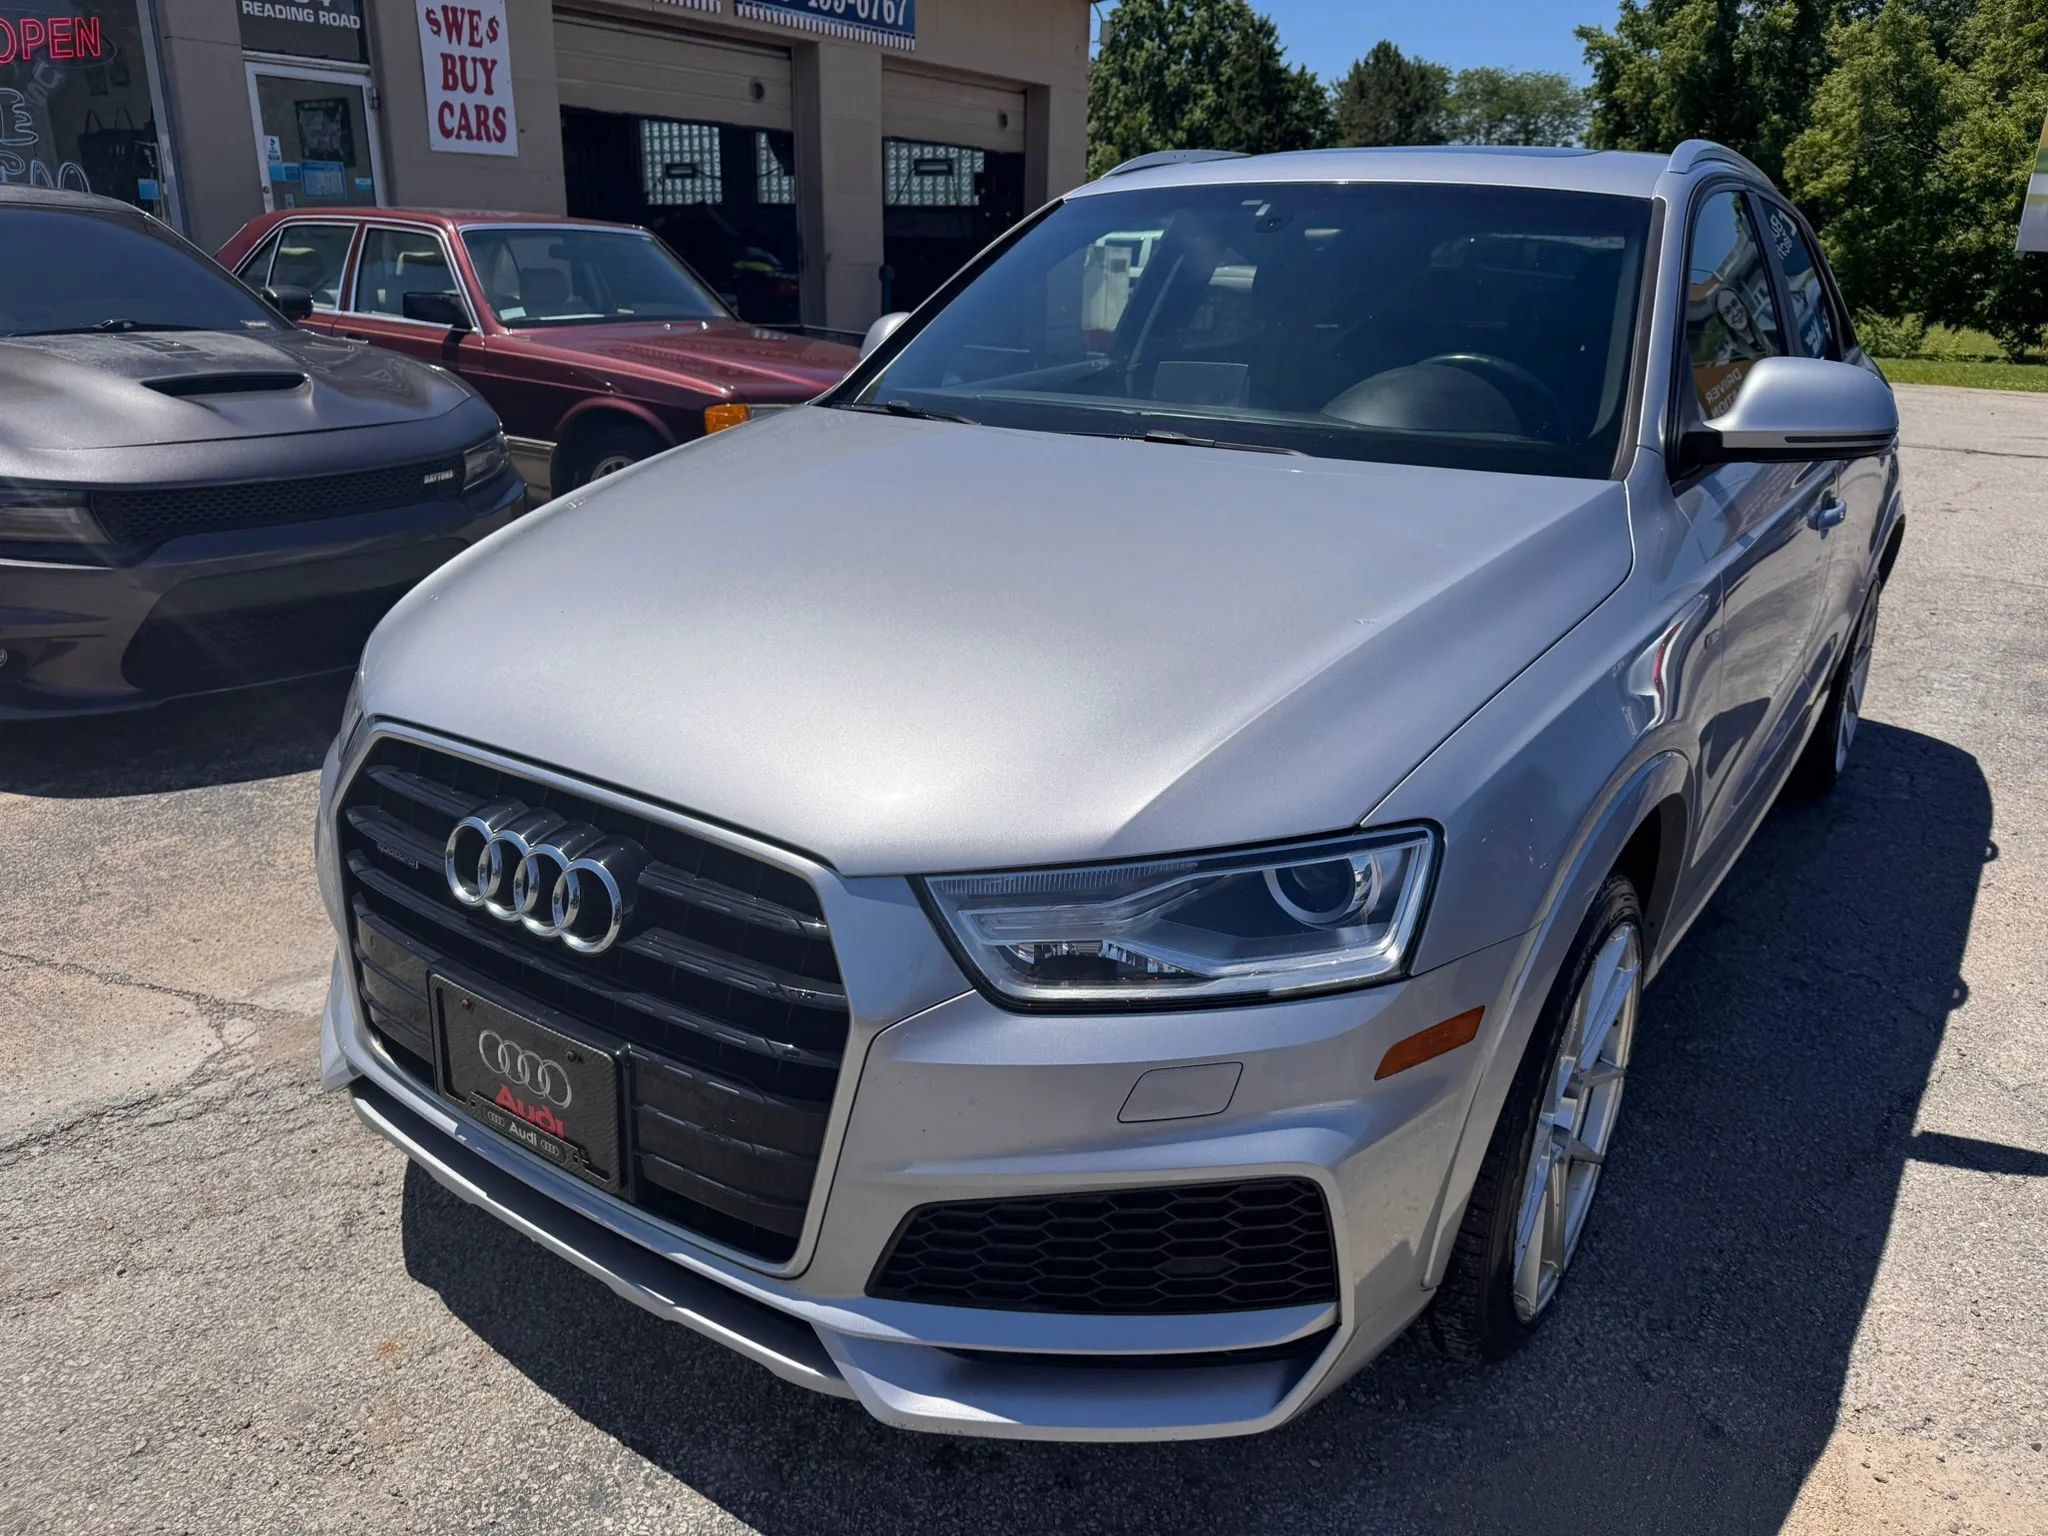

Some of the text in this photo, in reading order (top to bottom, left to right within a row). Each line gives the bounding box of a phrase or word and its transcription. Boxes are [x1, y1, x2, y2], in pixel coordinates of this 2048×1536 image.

[242, 1, 361, 29] READING ROAD
[440, 52, 497, 96] BUY
[438, 101, 507, 143] CARS
[496, 1083, 564, 1138] Audi
[509, 1121, 537, 1147] Audi
